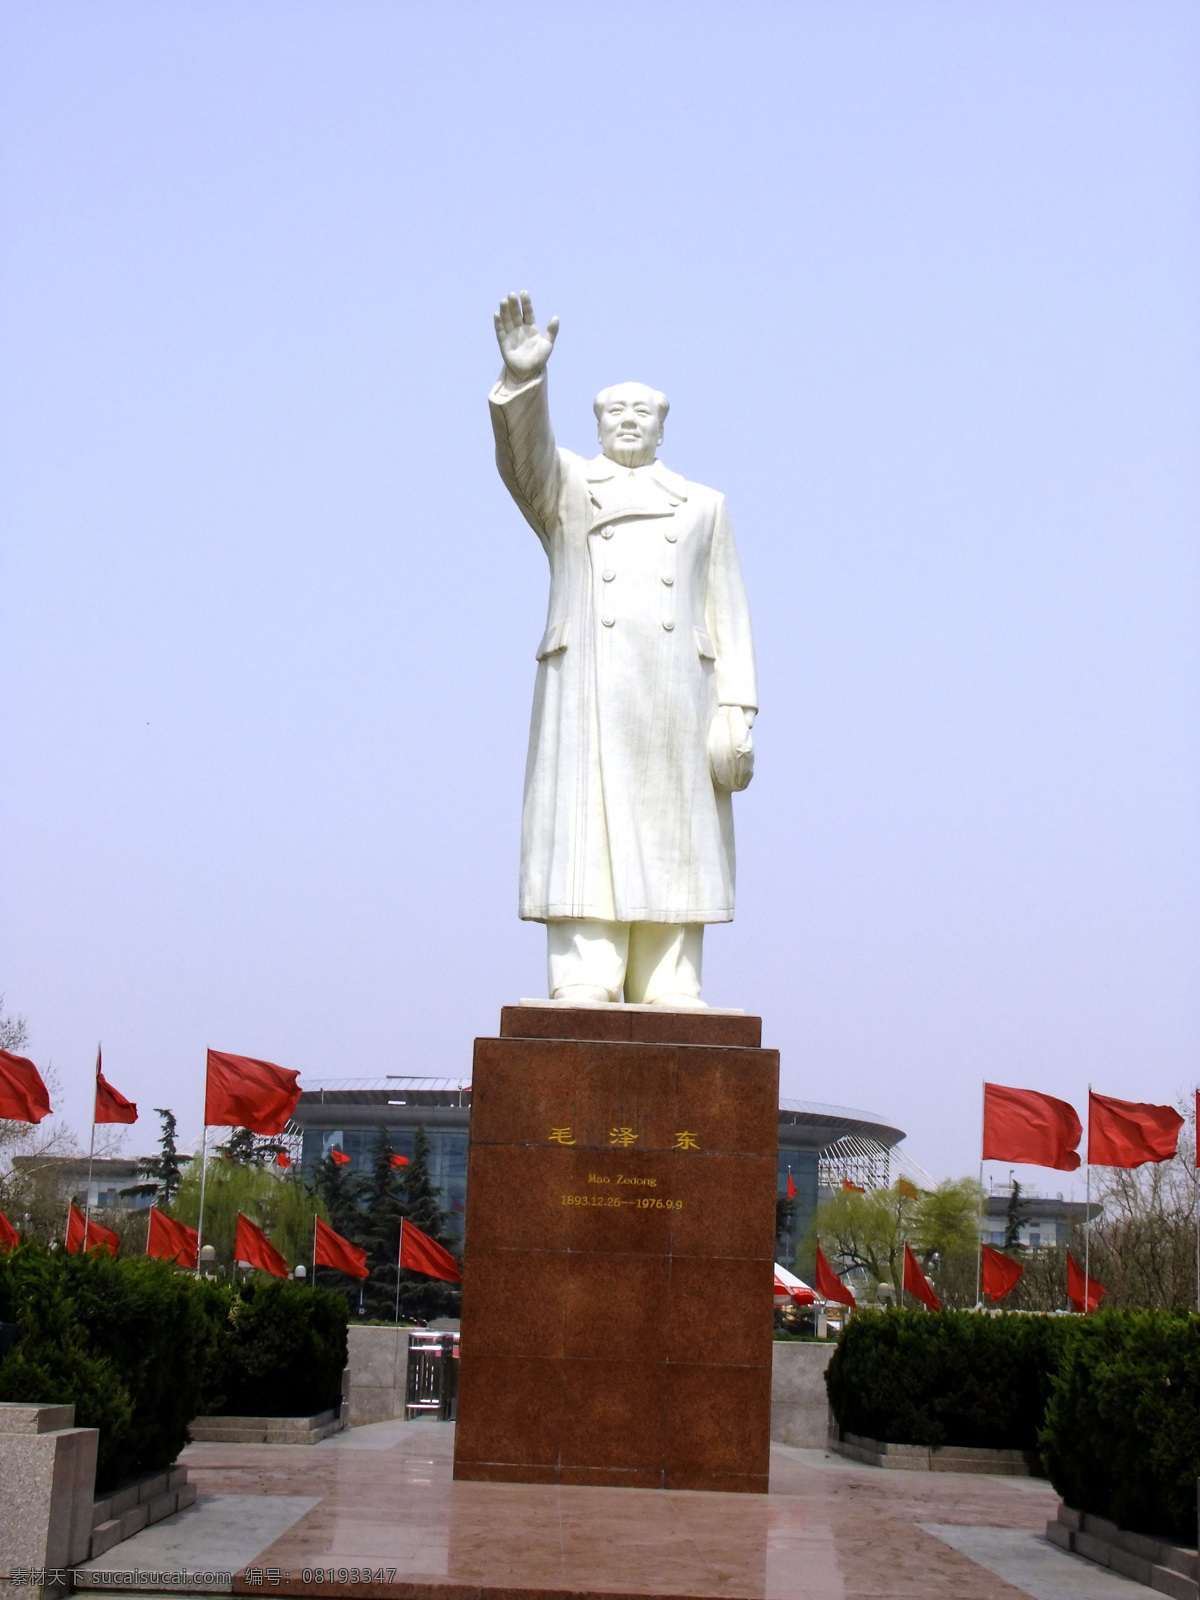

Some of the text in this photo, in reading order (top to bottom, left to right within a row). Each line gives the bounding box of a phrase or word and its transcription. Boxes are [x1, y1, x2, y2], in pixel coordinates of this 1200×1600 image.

[548, 1127, 700, 1150] 毛泽东
[588, 1173, 611, 1184] Mao
